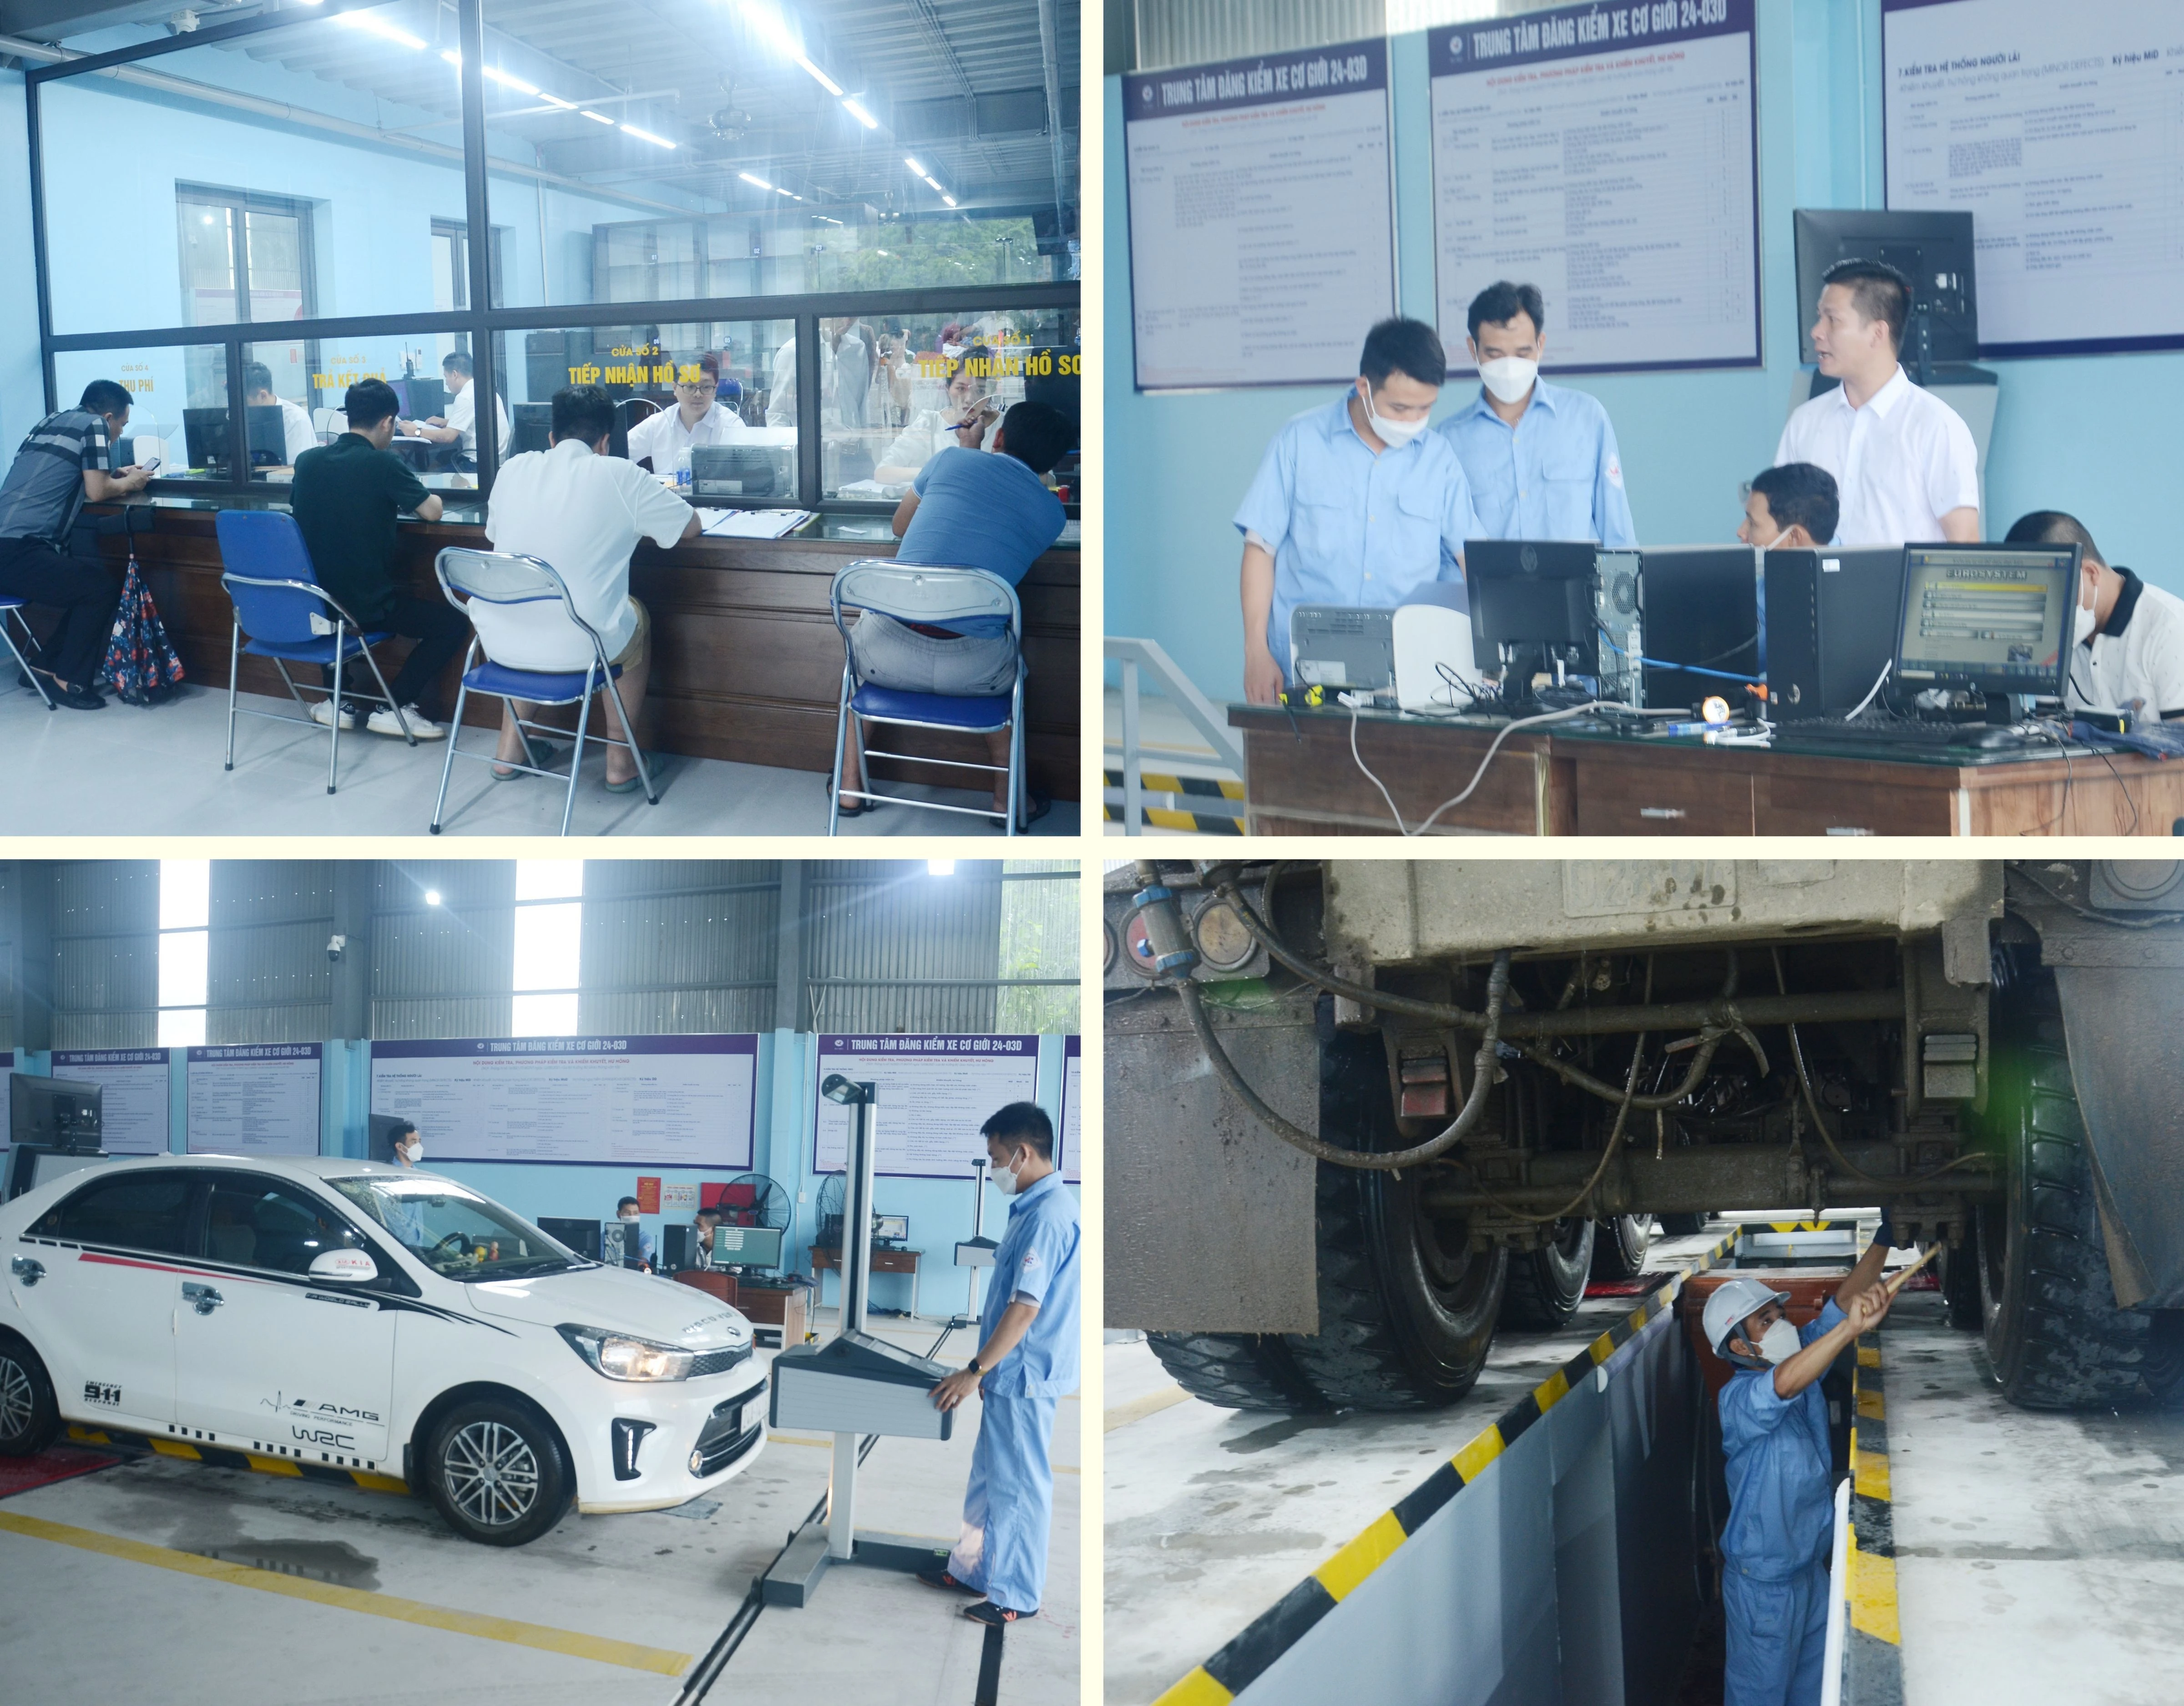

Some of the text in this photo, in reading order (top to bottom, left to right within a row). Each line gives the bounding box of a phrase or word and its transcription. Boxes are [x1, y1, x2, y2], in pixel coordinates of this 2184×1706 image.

[1474, 26, 1511, 60] TRUNG
[1513, 20, 1539, 55] TÂM
[1577, 3, 1609, 43] KIỂM
[1612, 10, 1628, 38] XE
[1631, 5, 1649, 35] CƠ
[1652, 0, 1678, 32] GIỚI
[1681, 0, 1727, 27] 24-03D
[1925, 64, 1937, 74] TRA
[1161, 79, 1193, 107] TRUNG
[1195, 73, 1216, 102] TÂM
[1248, 60, 1273, 95] KIỂM
[1275, 66, 1289, 91] XE
[1291, 61, 1305, 89] CƠ
[1331, 55, 1367, 84] 24-03D
[1003, 330, 1021, 345] SỐ
[1025, 335, 1031, 344] 1
[349, 353, 359, 363] SỐ
[612, 343, 658, 357] CỬA SỐ 2
[135, 362, 143, 371] SỐ
[918, 353, 959, 378] TIẾP
[965, 354, 1019, 381] NHẬN
[1026, 349, 1052, 376] HỒ
[313, 368, 334, 389] TRẢ
[338, 369, 359, 388] KẾT
[568, 360, 701, 387] TIẾP NHẬN HỒ SƠ
[138, 376, 153, 392] PHÍ
[207, 1049, 222, 1057] TRUNG
[223, 1047, 234, 1057] TÂM
[250, 1045, 263, 1056] KIỂM
[273, 1047, 280, 1055] CƠ
[281, 1045, 291, 1055] GIỚI
[293, 1047, 311, 1055] 24-03D
[490, 1038, 627, 1052] TRUNG TÂM ĐĂNG KIỂM XE CƠ GIỚI 24-03D
[852, 1035, 1022, 1051] TRUNG TÂM ĐĂNG KIỂM XE CƠ GIỚI 24-03D
[290, 1411, 353, 1427] DRIVING PERFORMANCE
[318, 1403, 379, 1421] AMG
[292, 1425, 355, 1450] WRC
